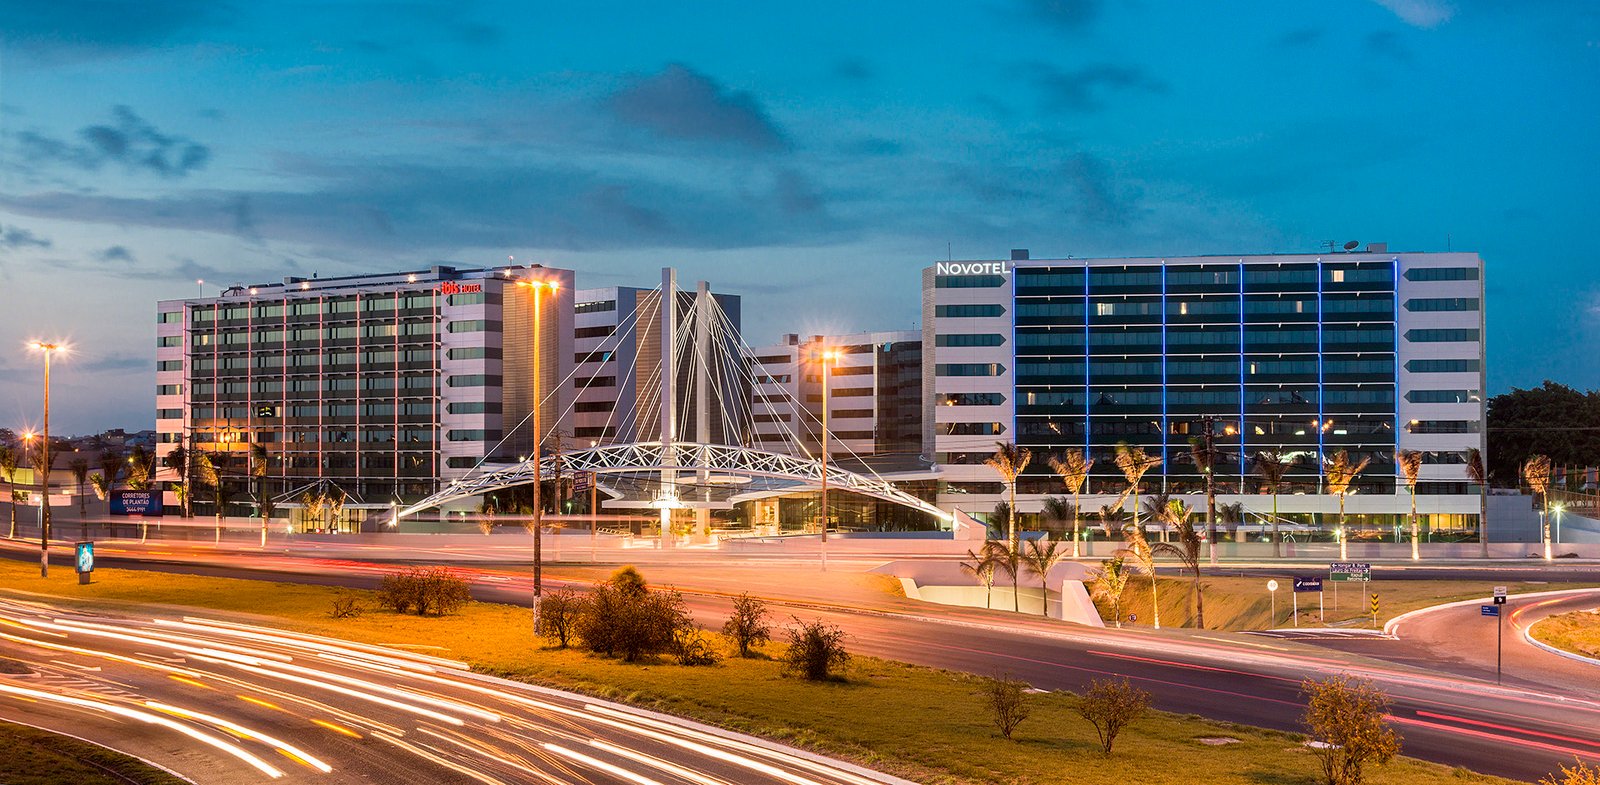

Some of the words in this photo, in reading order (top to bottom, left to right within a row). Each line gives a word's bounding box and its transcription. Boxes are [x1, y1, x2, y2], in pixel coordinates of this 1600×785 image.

[937, 261, 1011, 275] NOVOTEL
[441, 281, 460, 294] ibis
[461, 284, 481, 293] HOTEL
